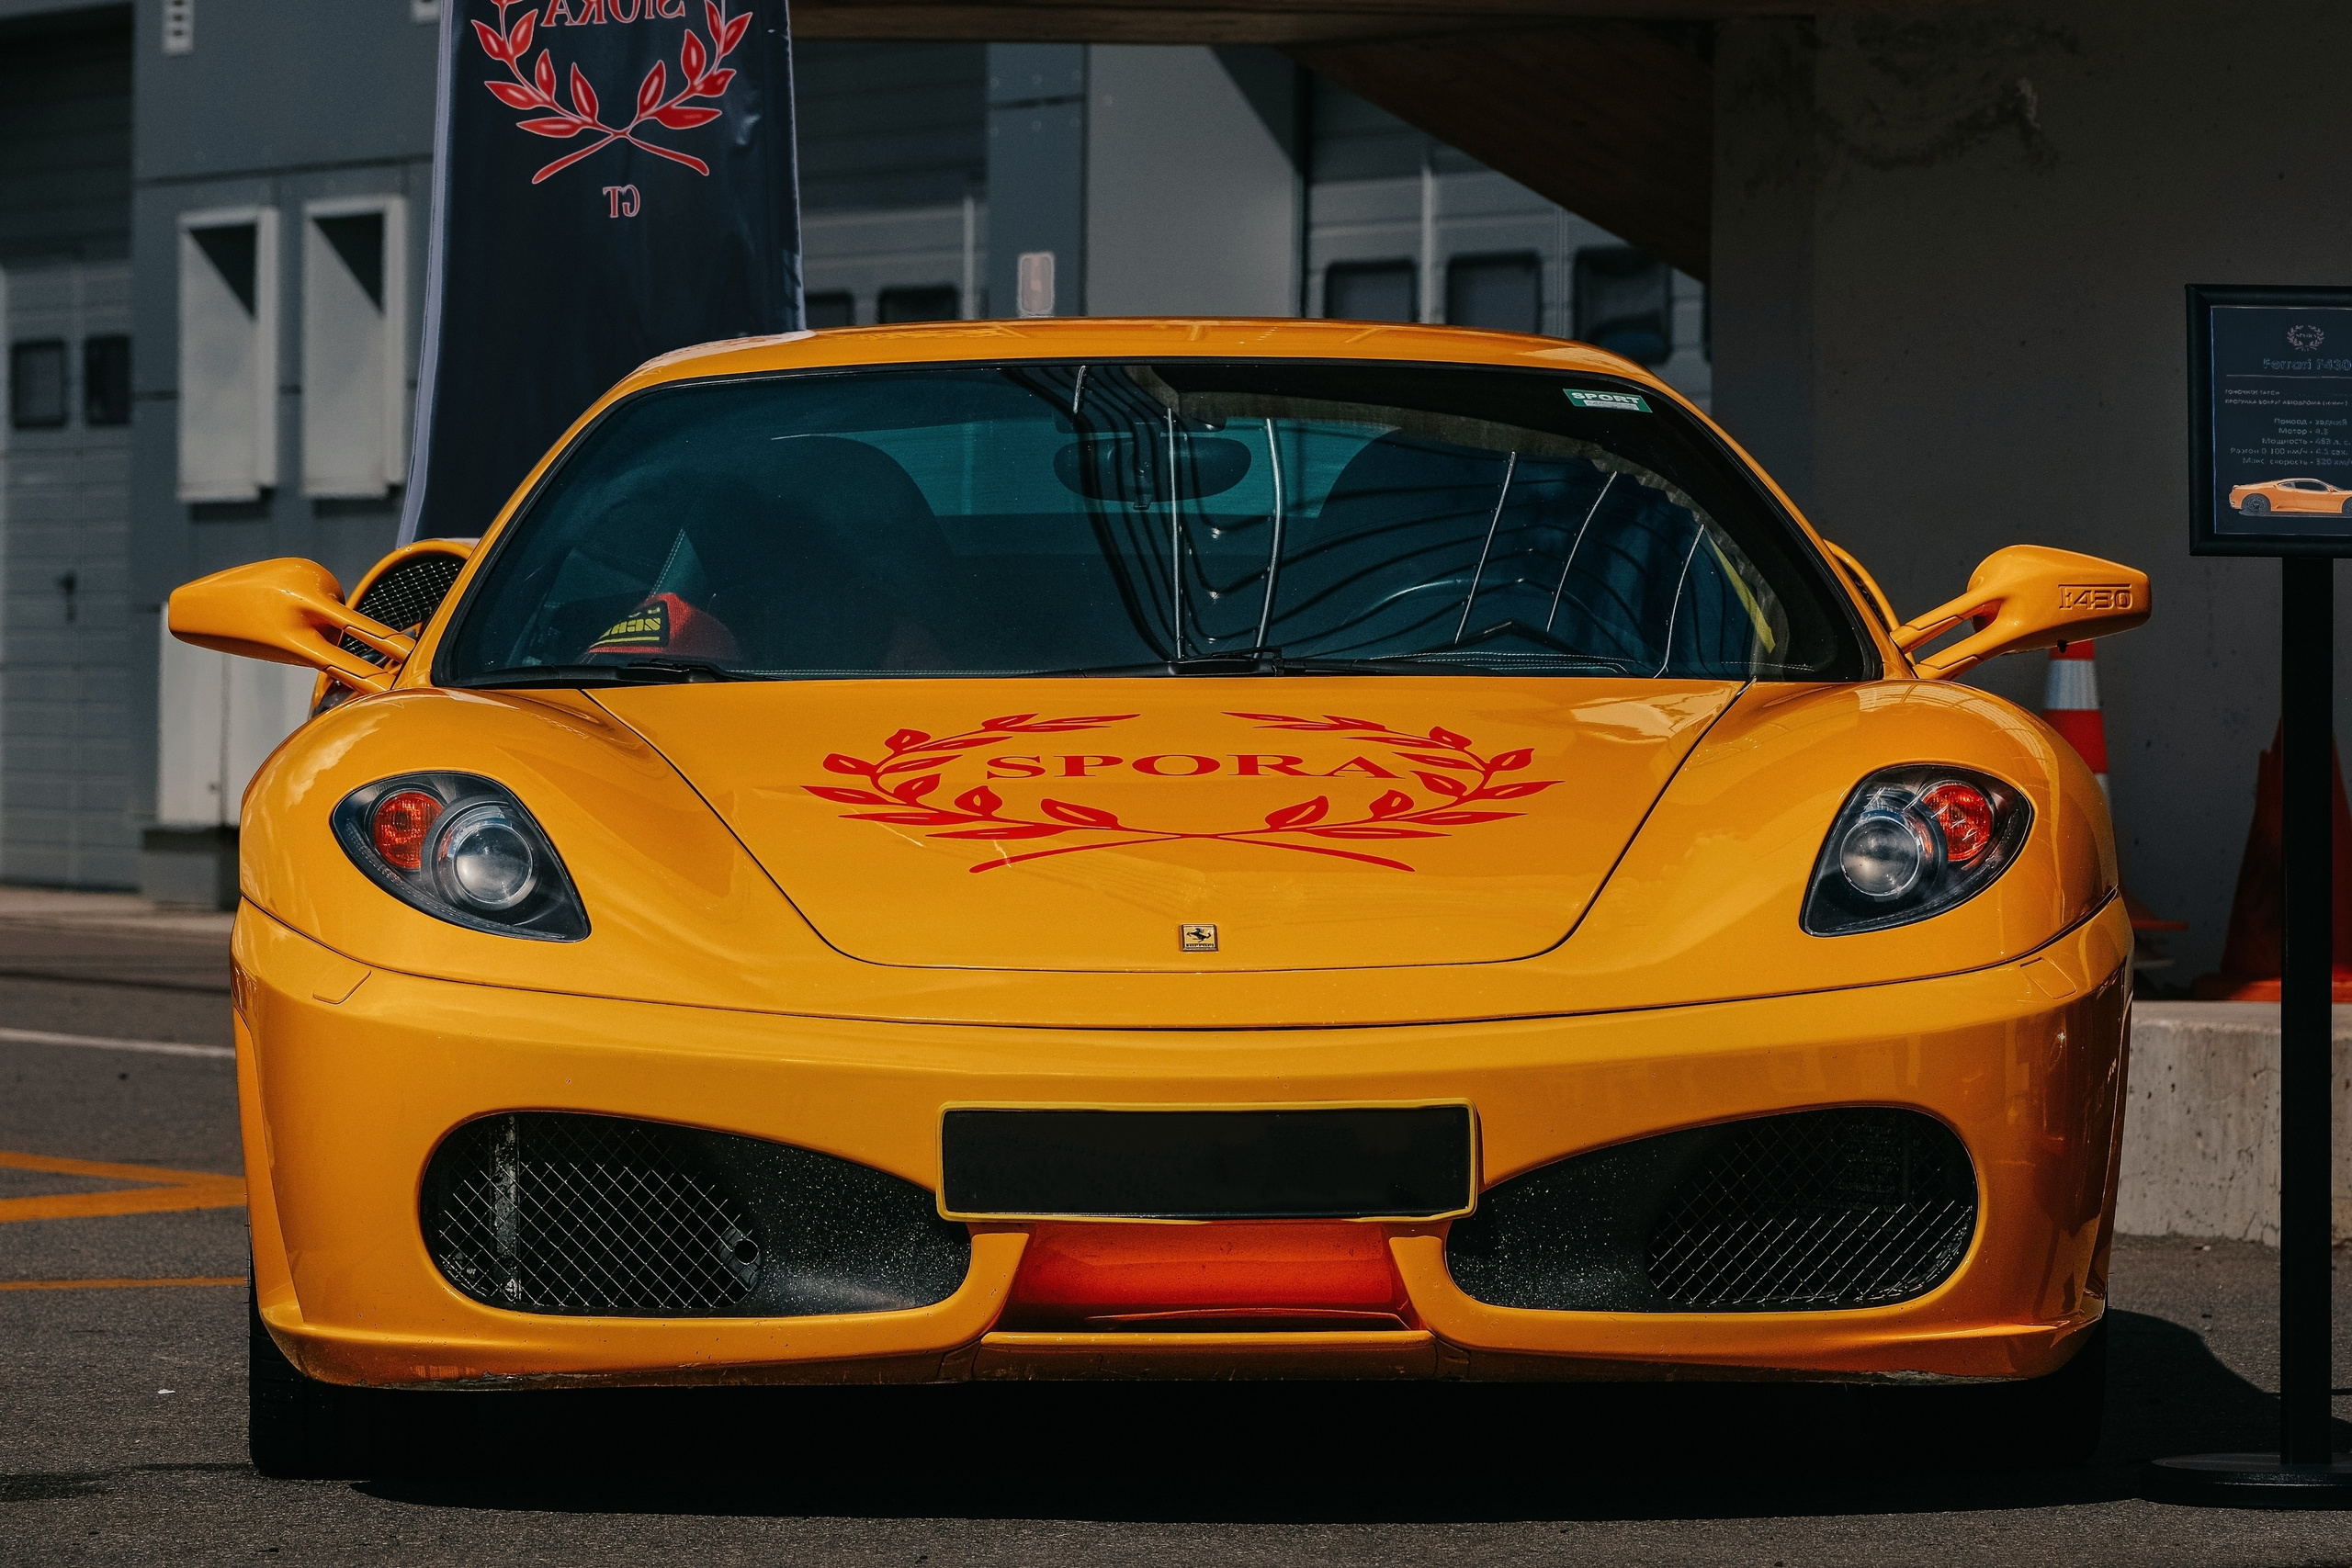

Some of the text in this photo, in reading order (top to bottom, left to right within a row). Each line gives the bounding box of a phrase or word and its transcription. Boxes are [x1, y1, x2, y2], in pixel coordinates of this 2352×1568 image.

[2263, 357, 2352, 371] Ferrari F430
[1572, 392, 1640, 404] SPORT
[2278, 427, 2308, 435] Мотор
[2058, 584, 2132, 610] F430
[986, 753, 1406, 780] SPORA
